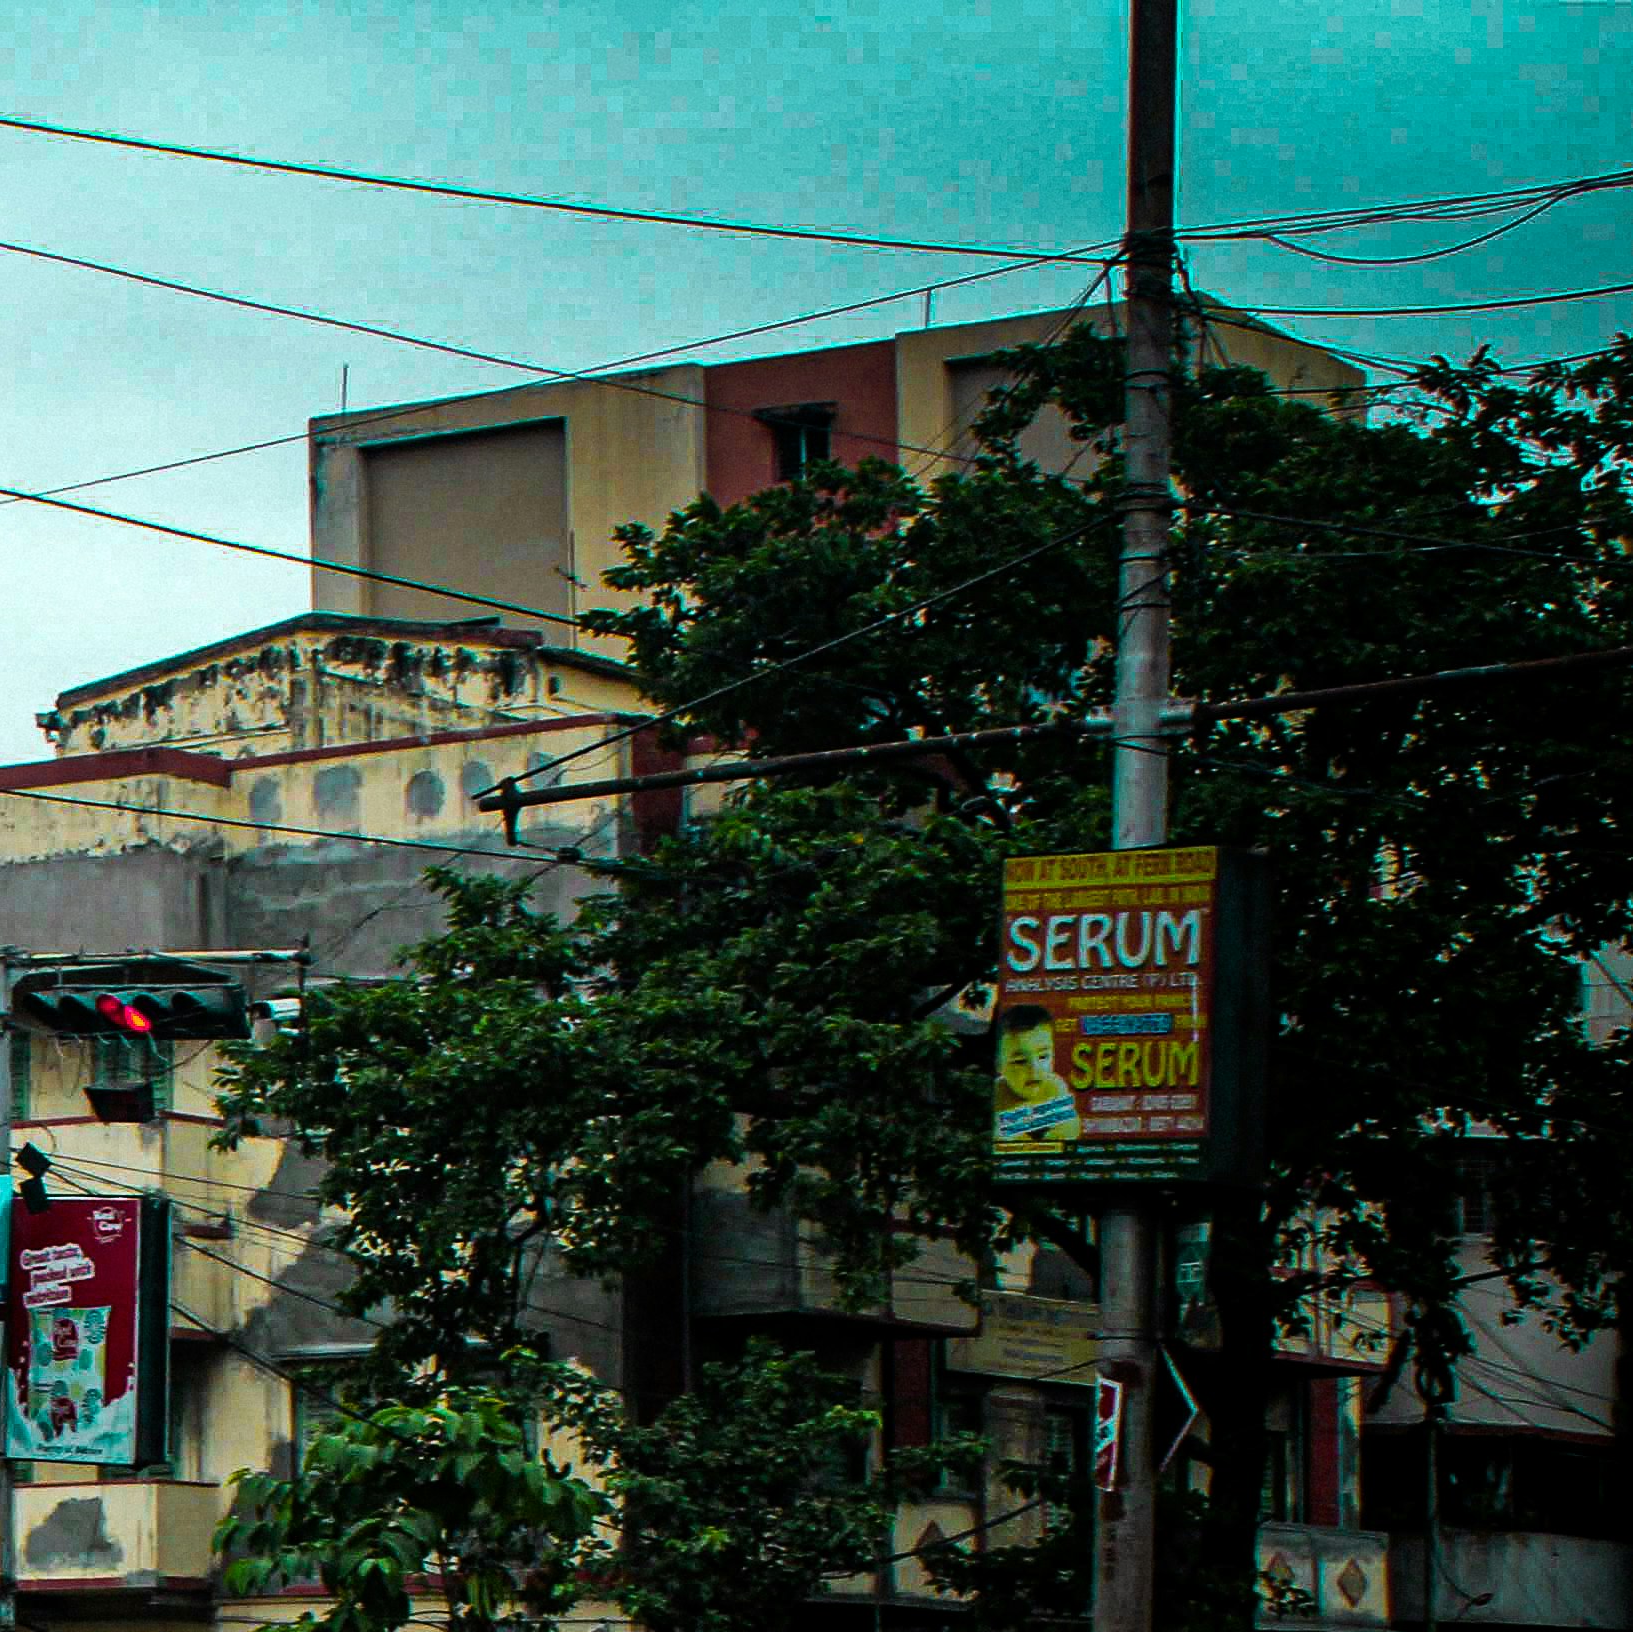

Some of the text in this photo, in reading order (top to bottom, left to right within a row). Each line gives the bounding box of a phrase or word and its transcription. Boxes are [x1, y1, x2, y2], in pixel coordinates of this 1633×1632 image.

[1006, 909, 1202, 973] SERUM
[1005, 977, 1079, 993] ANALYSIS
[1081, 974, 1139, 989] CENTRE
[1071, 1041, 1200, 1089] SERUM
